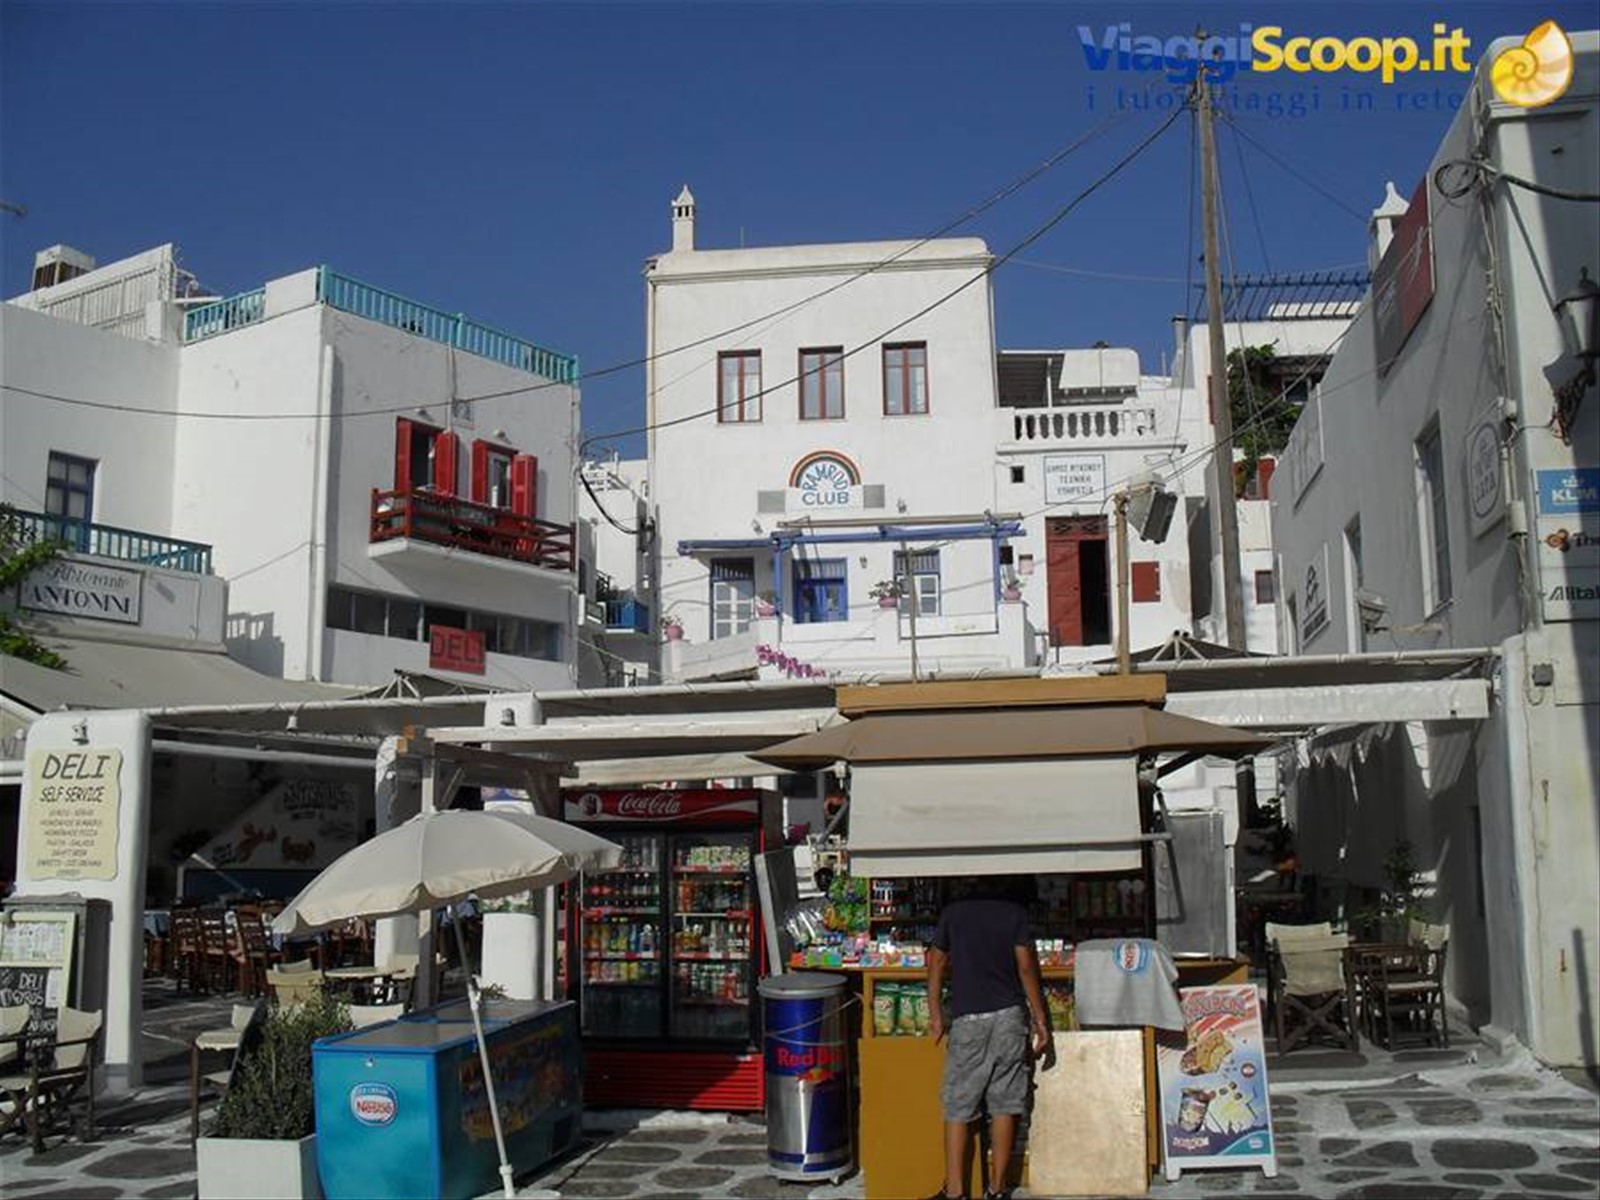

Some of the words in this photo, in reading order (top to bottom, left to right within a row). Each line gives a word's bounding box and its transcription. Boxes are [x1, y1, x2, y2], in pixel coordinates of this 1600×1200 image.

[802, 491, 849, 506] CLUB
[1552, 488, 1597, 502] KLM
[430, 631, 484, 665] DELI
[42, 753, 110, 780] DELI
[40, 785, 64, 803] SELF
[66, 785, 106, 803] SERVICE
[776, 1046, 816, 1068] Red
